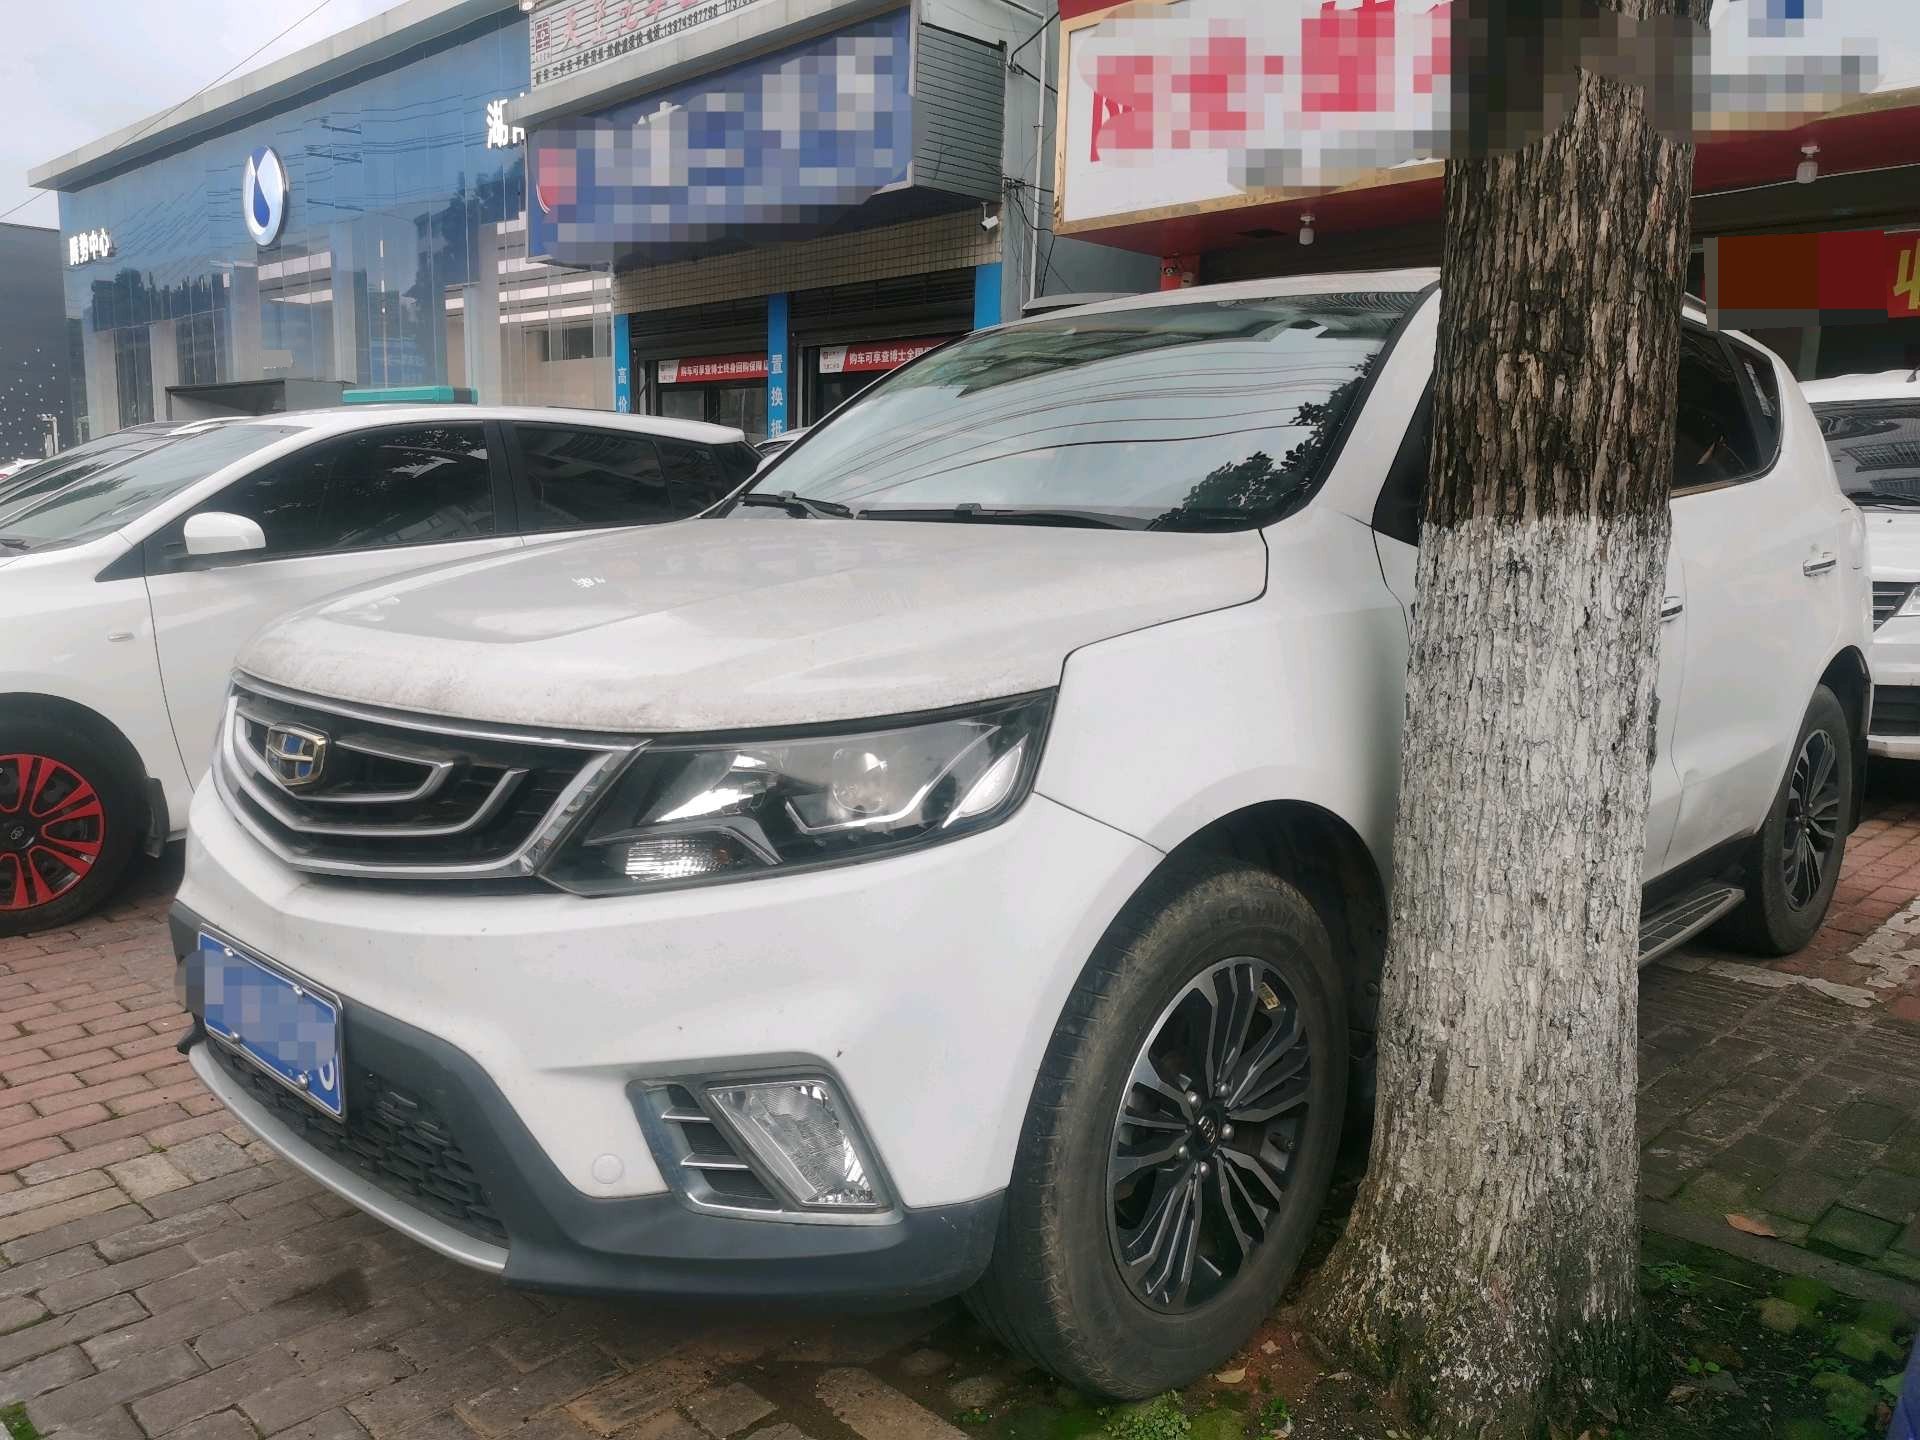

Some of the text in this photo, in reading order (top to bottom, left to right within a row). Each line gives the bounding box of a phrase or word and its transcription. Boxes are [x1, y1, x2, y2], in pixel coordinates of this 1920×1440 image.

[69, 228, 111, 266] 腾势中心
[617, 366, 628, 413] 高价
